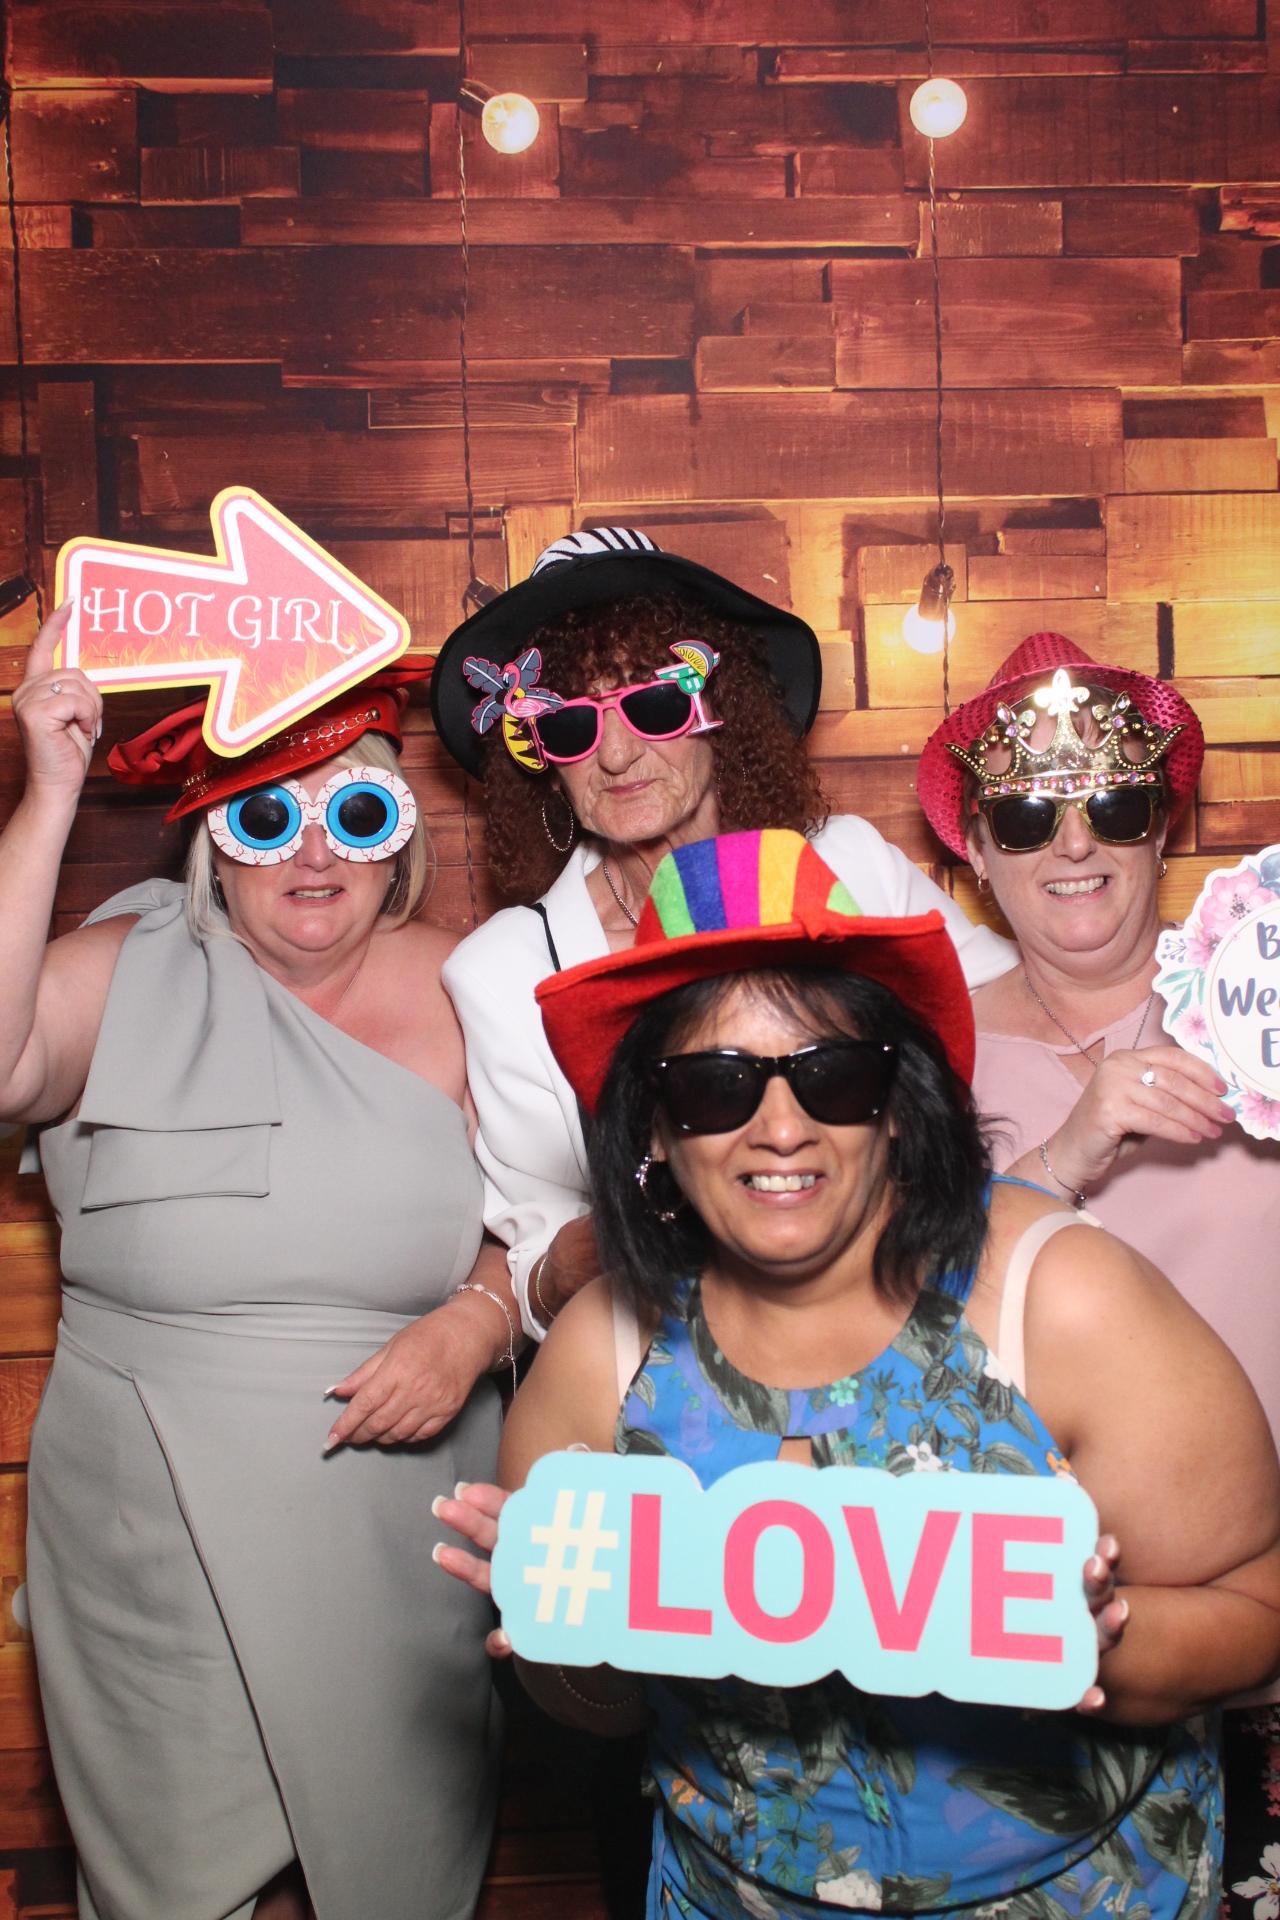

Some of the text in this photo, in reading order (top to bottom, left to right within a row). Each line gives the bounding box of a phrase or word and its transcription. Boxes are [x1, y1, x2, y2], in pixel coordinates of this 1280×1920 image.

[83, 587, 359, 654] HOT GIRL
[1218, 977, 1280, 1017] We
[523, 1489, 1064, 1663] #LOVE
